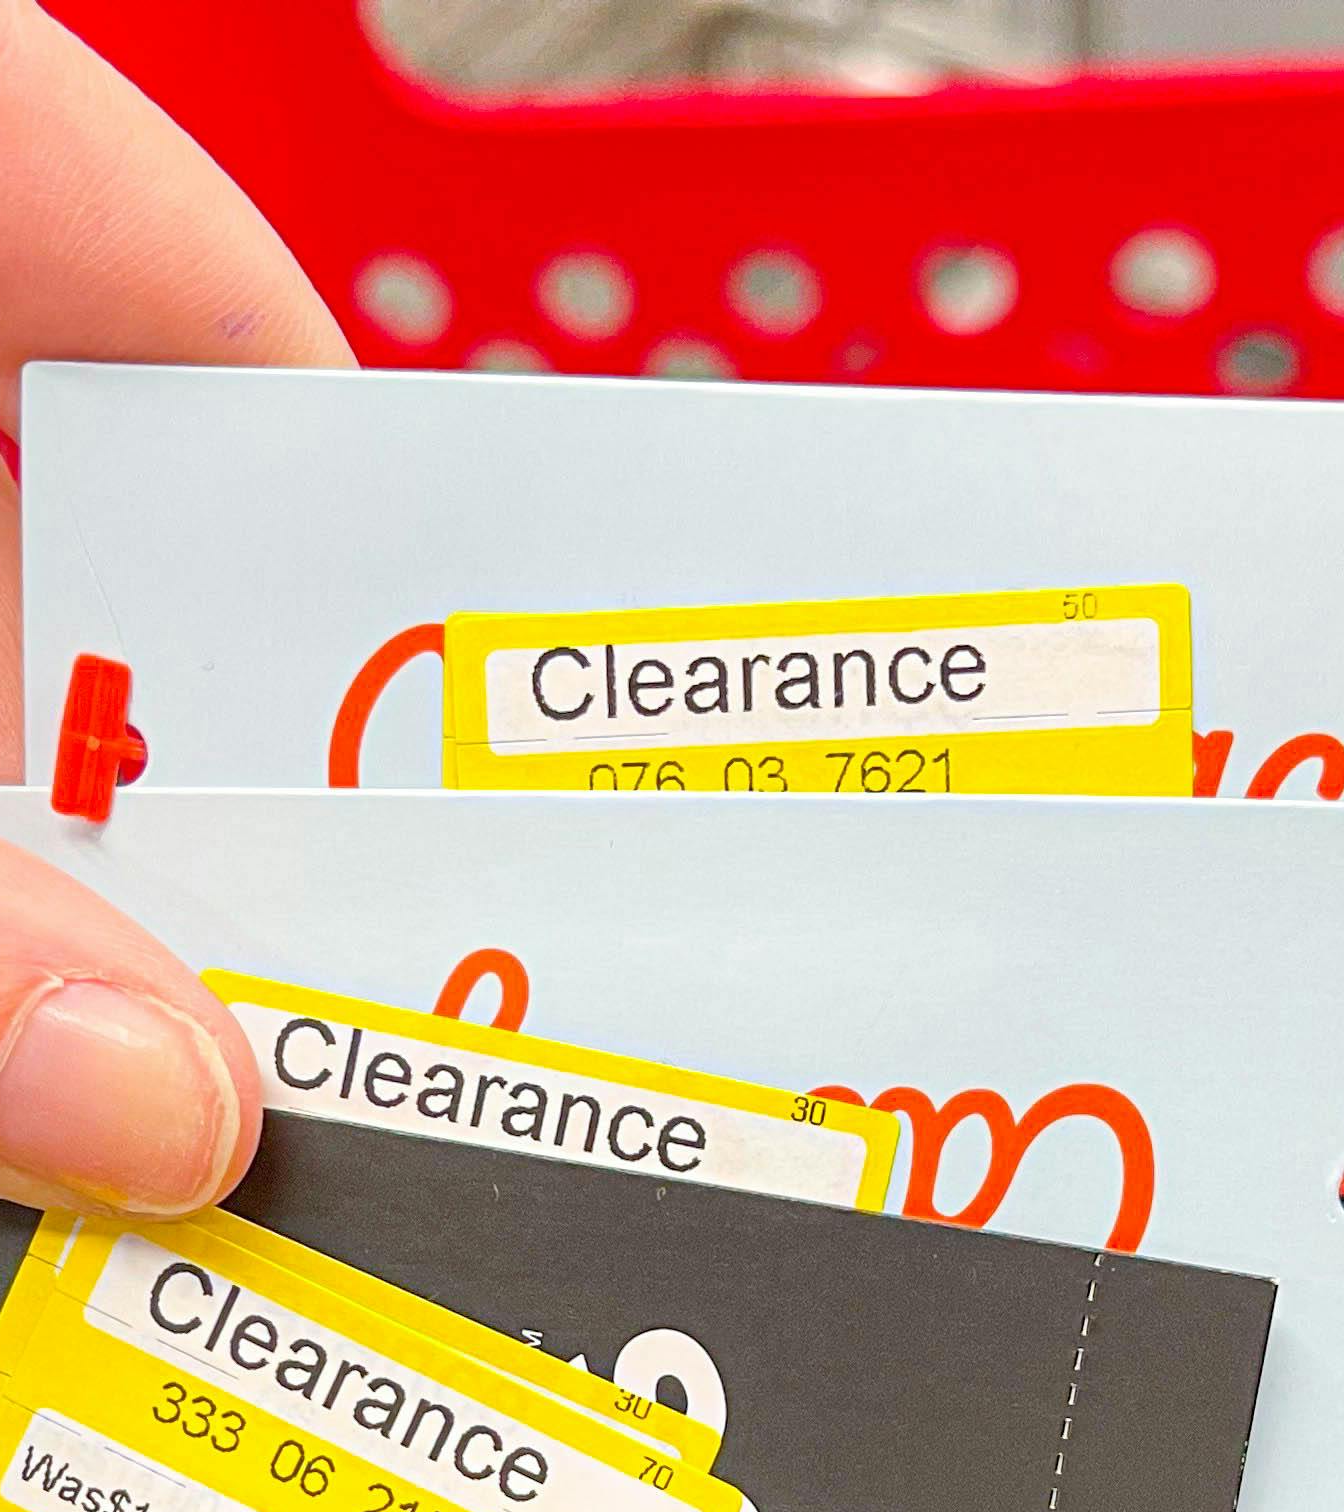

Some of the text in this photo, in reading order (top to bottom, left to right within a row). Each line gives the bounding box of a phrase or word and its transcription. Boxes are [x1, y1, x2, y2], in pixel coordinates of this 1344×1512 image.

[1062, 593, 1098, 620] 50
[531, 643, 987, 722] Clearance
[824, 748, 952, 793] 7621
[273, 1018, 707, 1171] Clearance
[790, 1095, 826, 1127] 30
[149, 1261, 548, 1502] Clearance
[613, 1388, 652, 1421] 30
[152, 1381, 247, 1453] 333
[269, 1439, 336, 1498] 06
[637, 1456, 674, 1492] 70
